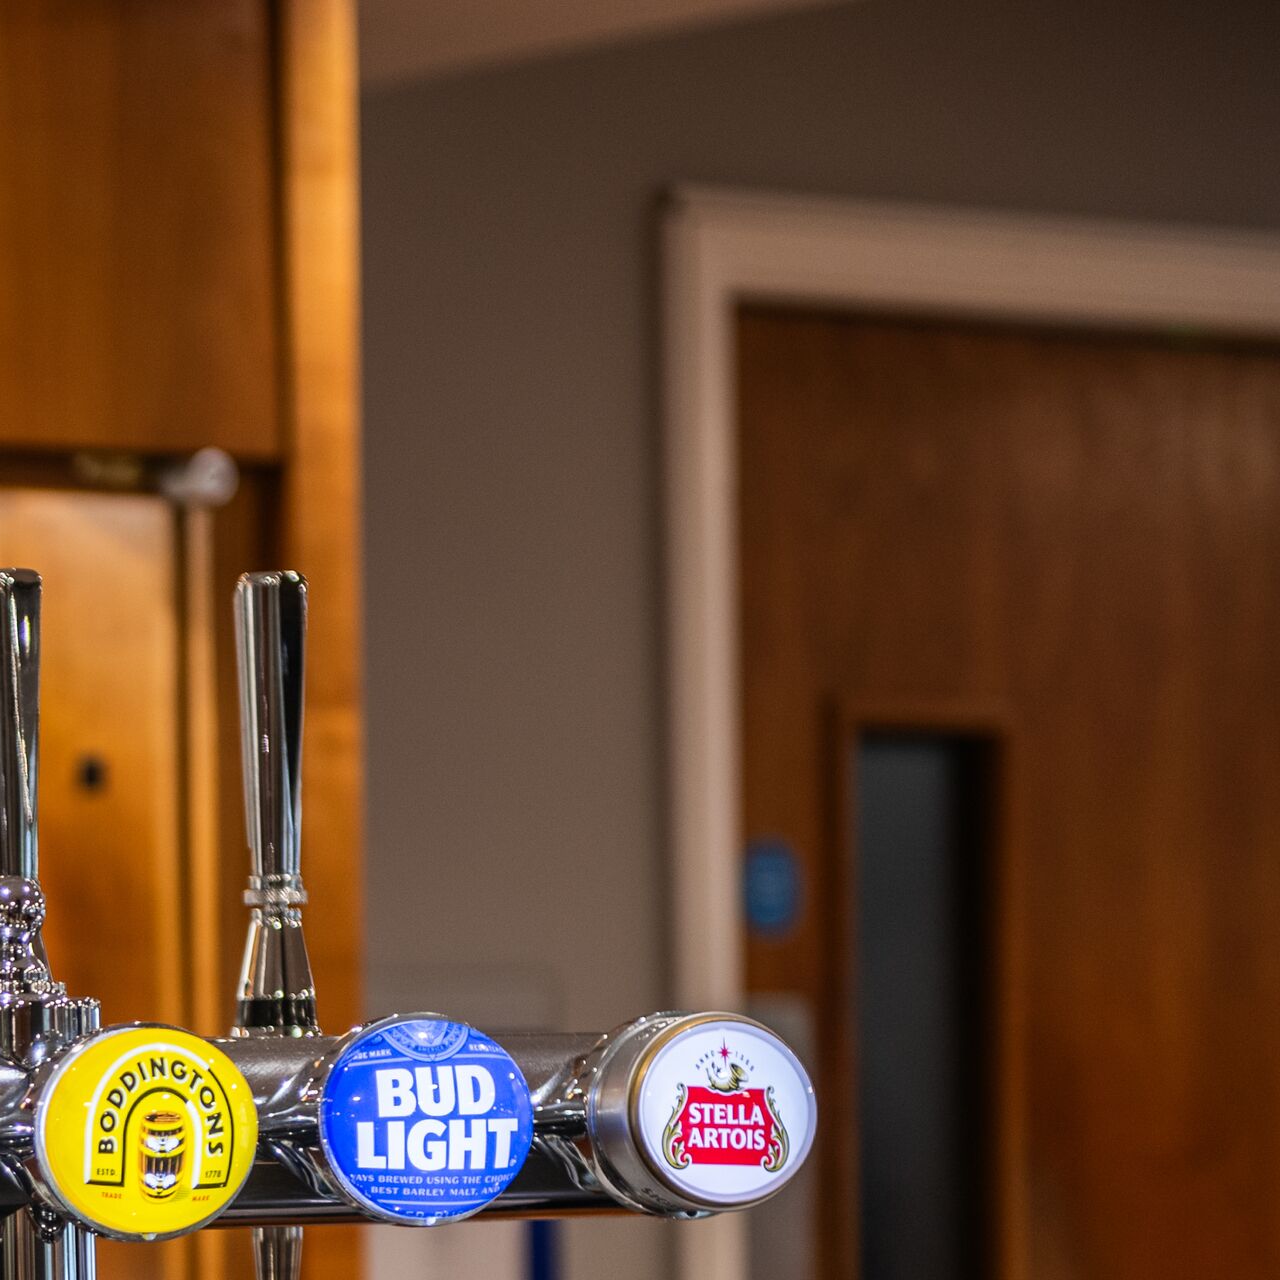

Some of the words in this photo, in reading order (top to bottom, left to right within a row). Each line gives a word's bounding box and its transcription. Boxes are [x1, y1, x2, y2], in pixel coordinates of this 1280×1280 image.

[375, 1064, 496, 1118] BUD
[98, 1057, 224, 1156] BODDINGTONS
[689, 1102, 765, 1127] STELLA
[357, 1118, 518, 1171] LIGHT
[688, 1127, 766, 1150] ARTOIS
[371, 1186, 399, 1195] BEST
[403, 1187, 446, 1196] BARLEY
[378, 1175, 423, 1184] BREWED
[426, 1176, 459, 1185] USING
[462, 1175, 482, 1184] THE
